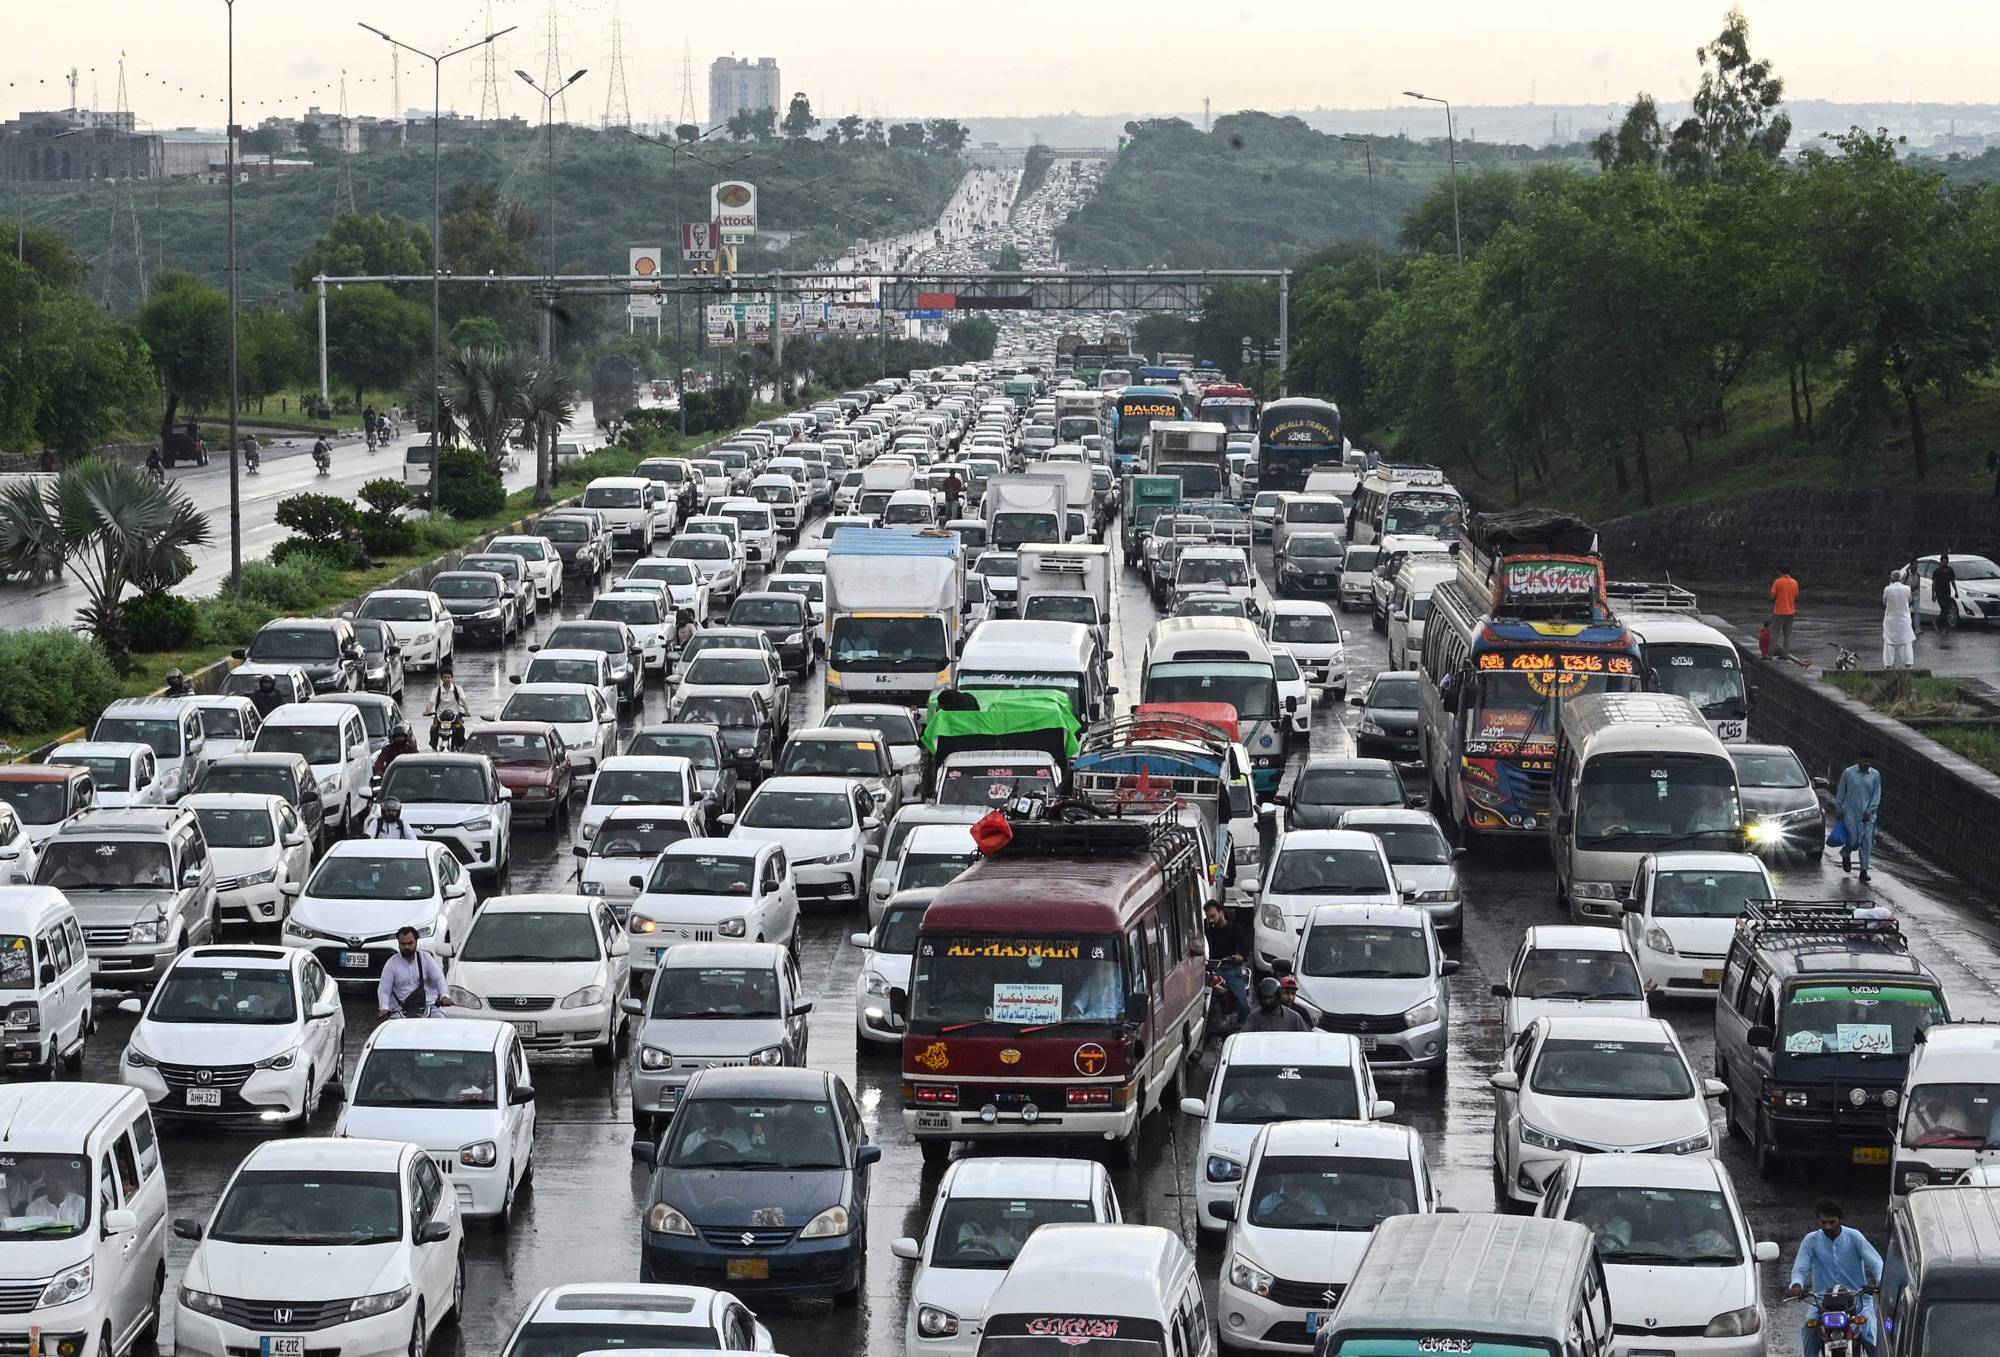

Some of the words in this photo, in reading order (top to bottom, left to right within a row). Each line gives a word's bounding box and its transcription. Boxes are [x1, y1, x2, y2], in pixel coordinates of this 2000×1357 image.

[689, 250, 712, 259] KFC
[719, 307, 733, 315] IVY
[1124, 404, 1176, 412] BALOCH
[1306, 420, 1335, 441] TRAVELS
[947, 939, 1080, 958] AL-HASNAIN
[1086, 1060, 1093, 1072] 1
[204, 1093, 217, 1103] 321
[275, 1340, 299, 1352] AE-212
